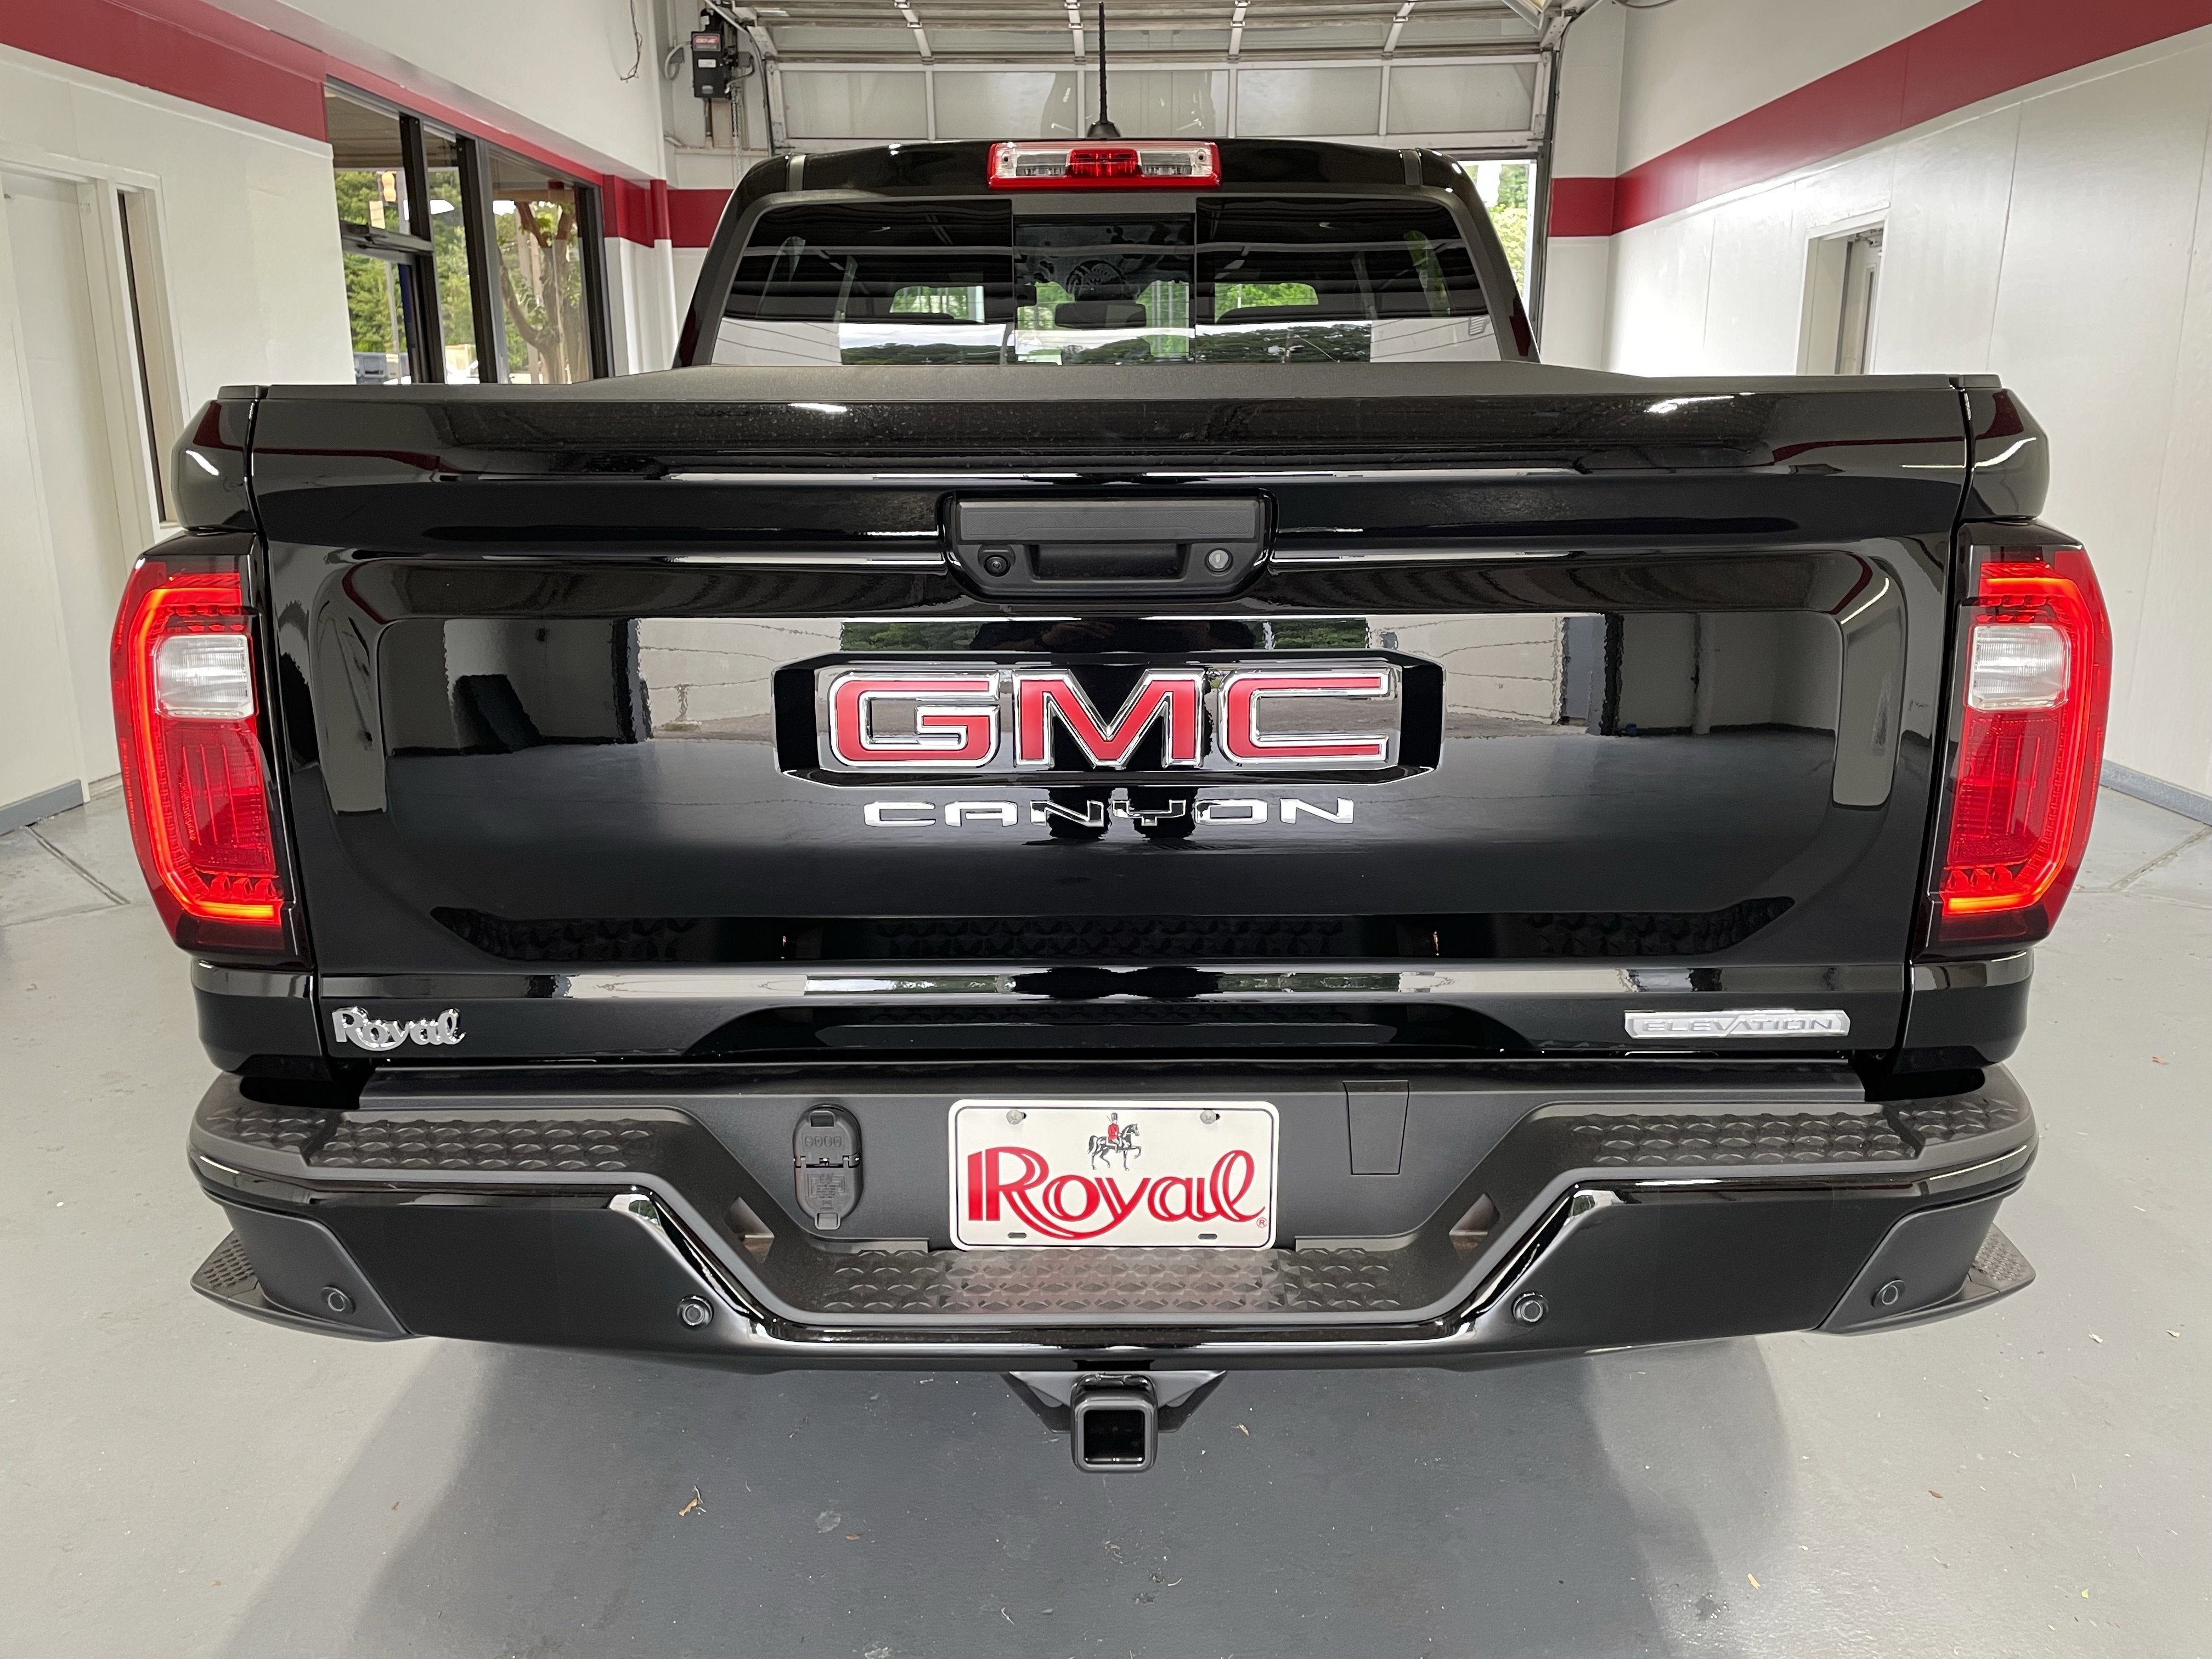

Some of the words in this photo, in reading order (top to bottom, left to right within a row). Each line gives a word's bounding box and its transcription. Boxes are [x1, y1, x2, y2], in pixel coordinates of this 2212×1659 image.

[827, 668, 1390, 768] GMC
[864, 798, 1355, 826] CANYON
[332, 1007, 466, 1051] Royal
[1643, 1018, 1832, 1031] ELEVATION
[968, 1146, 1266, 1240] Royal
